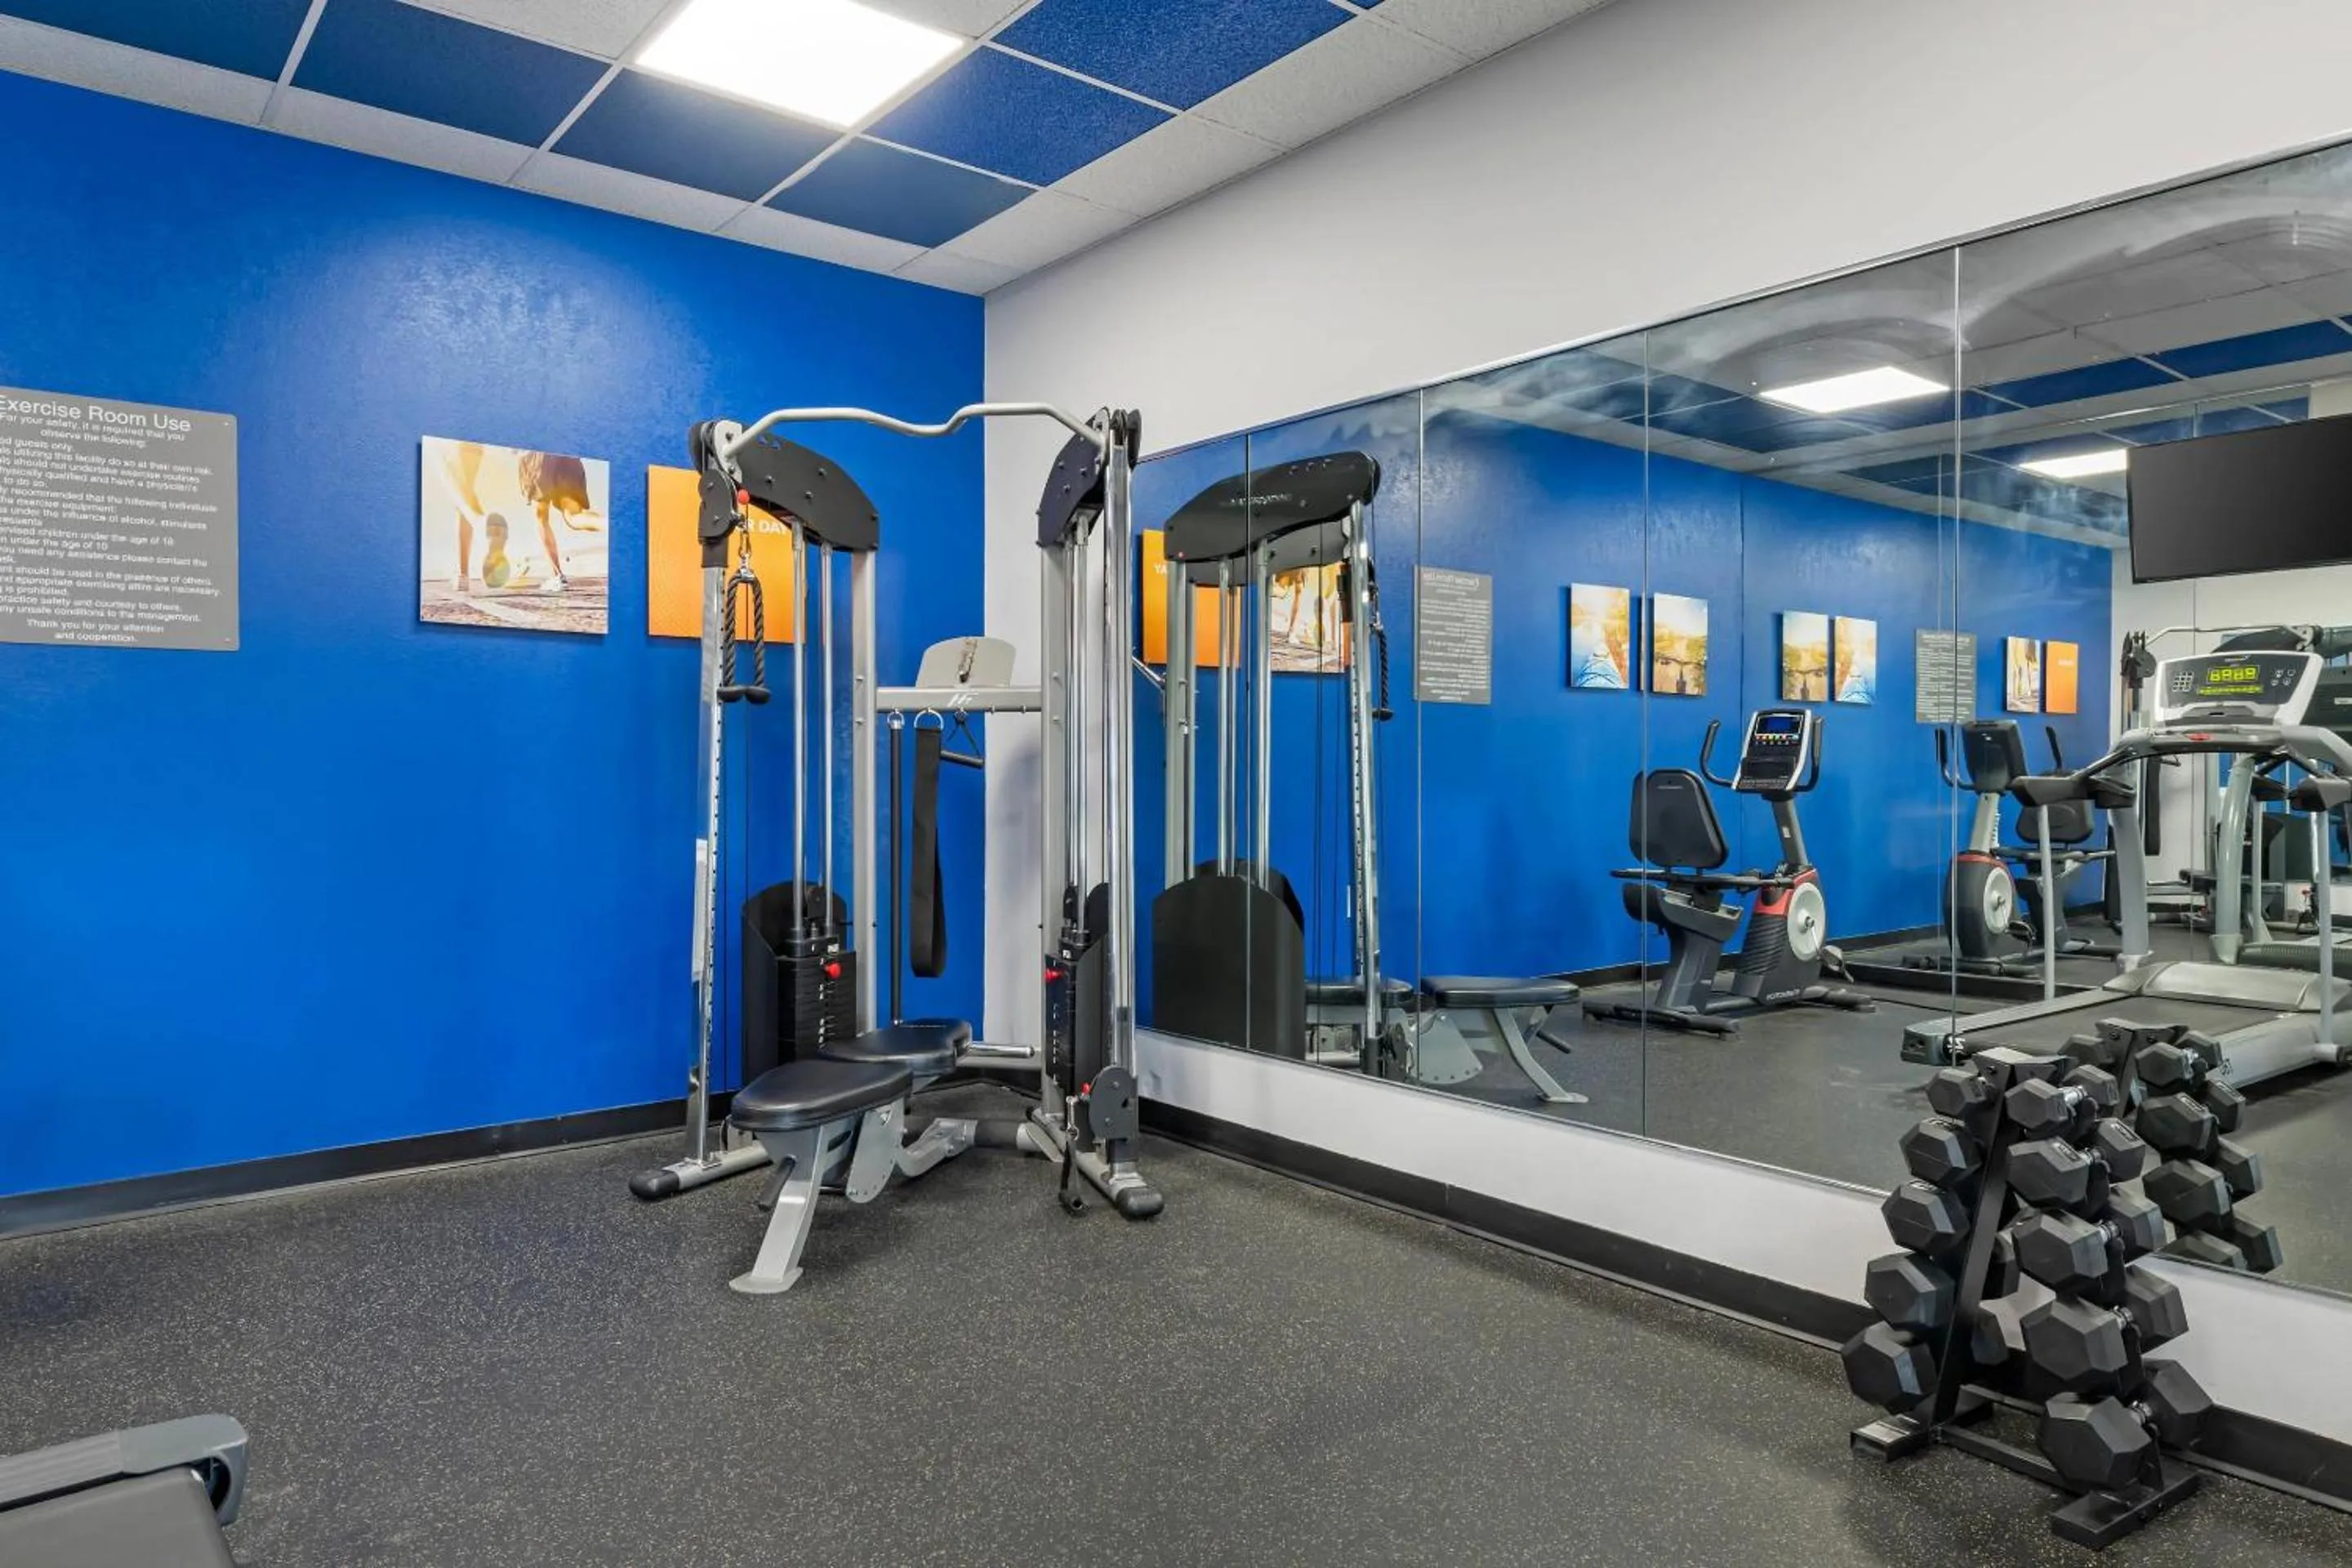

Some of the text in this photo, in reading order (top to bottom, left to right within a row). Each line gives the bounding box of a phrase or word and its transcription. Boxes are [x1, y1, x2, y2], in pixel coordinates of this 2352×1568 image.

[0, 394, 190, 431] Exercise Room Use
